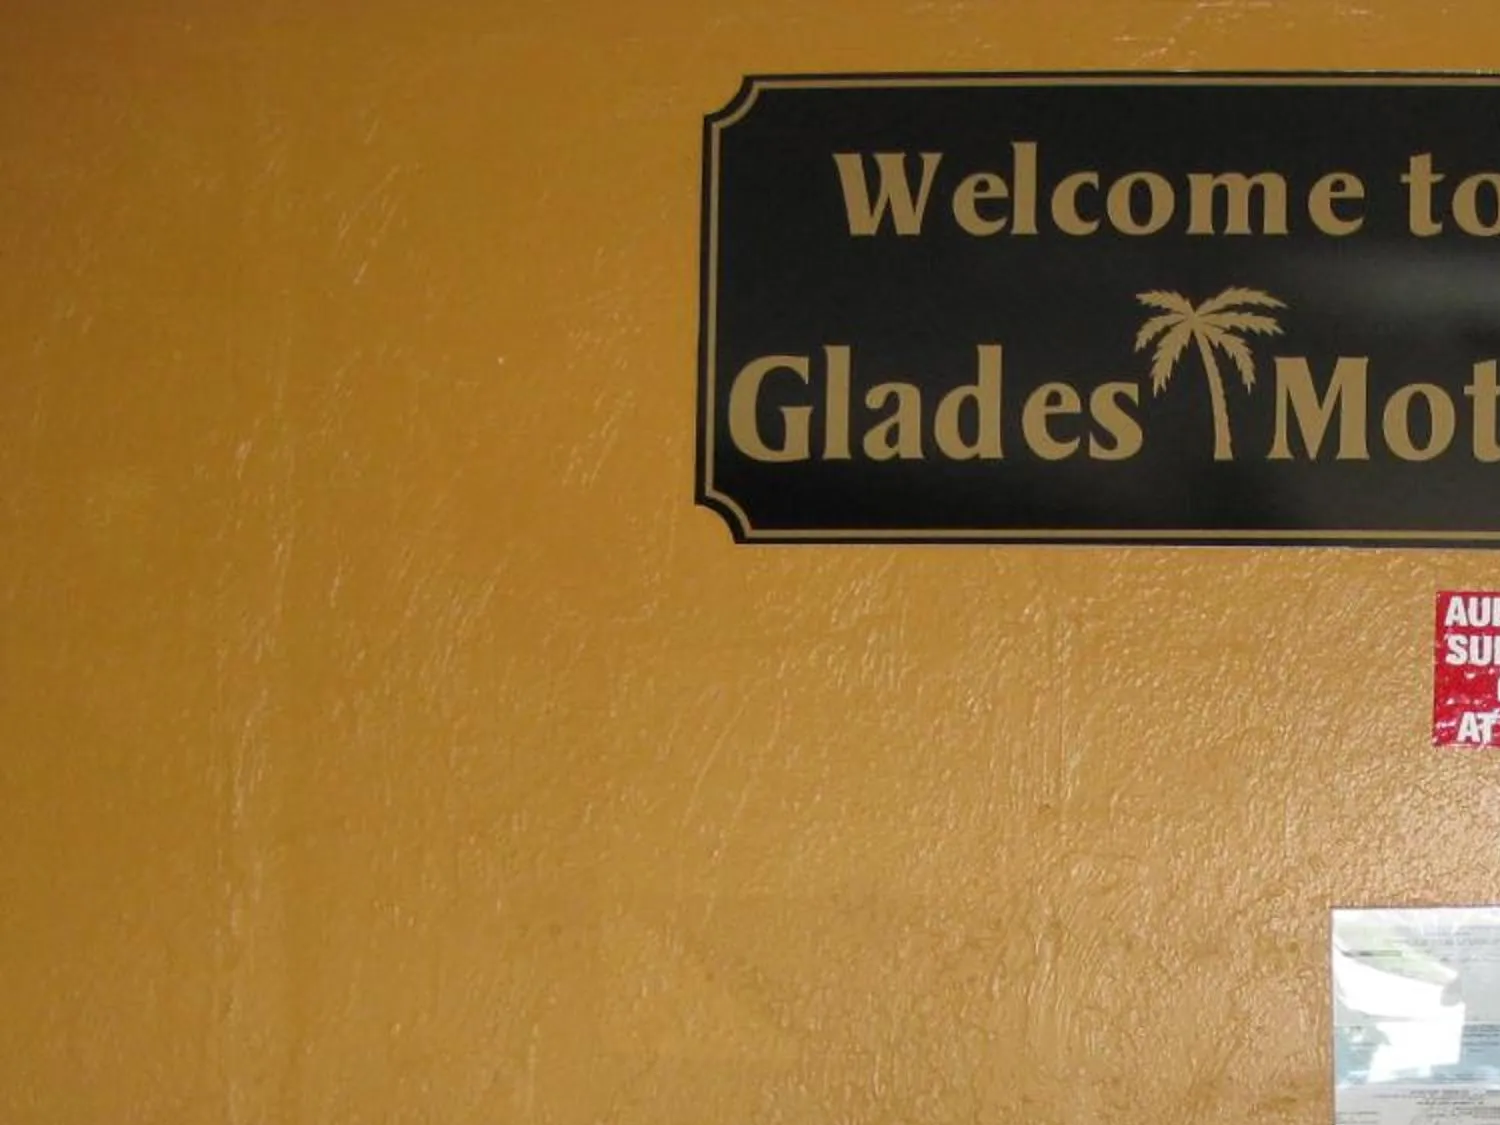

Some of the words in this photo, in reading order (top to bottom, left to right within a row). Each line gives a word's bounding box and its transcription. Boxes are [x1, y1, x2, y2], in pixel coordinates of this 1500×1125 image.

[832, 141, 1366, 237] Welcome
[728, 344, 1144, 463] Glades
[1457, 711, 1494, 743] AT
